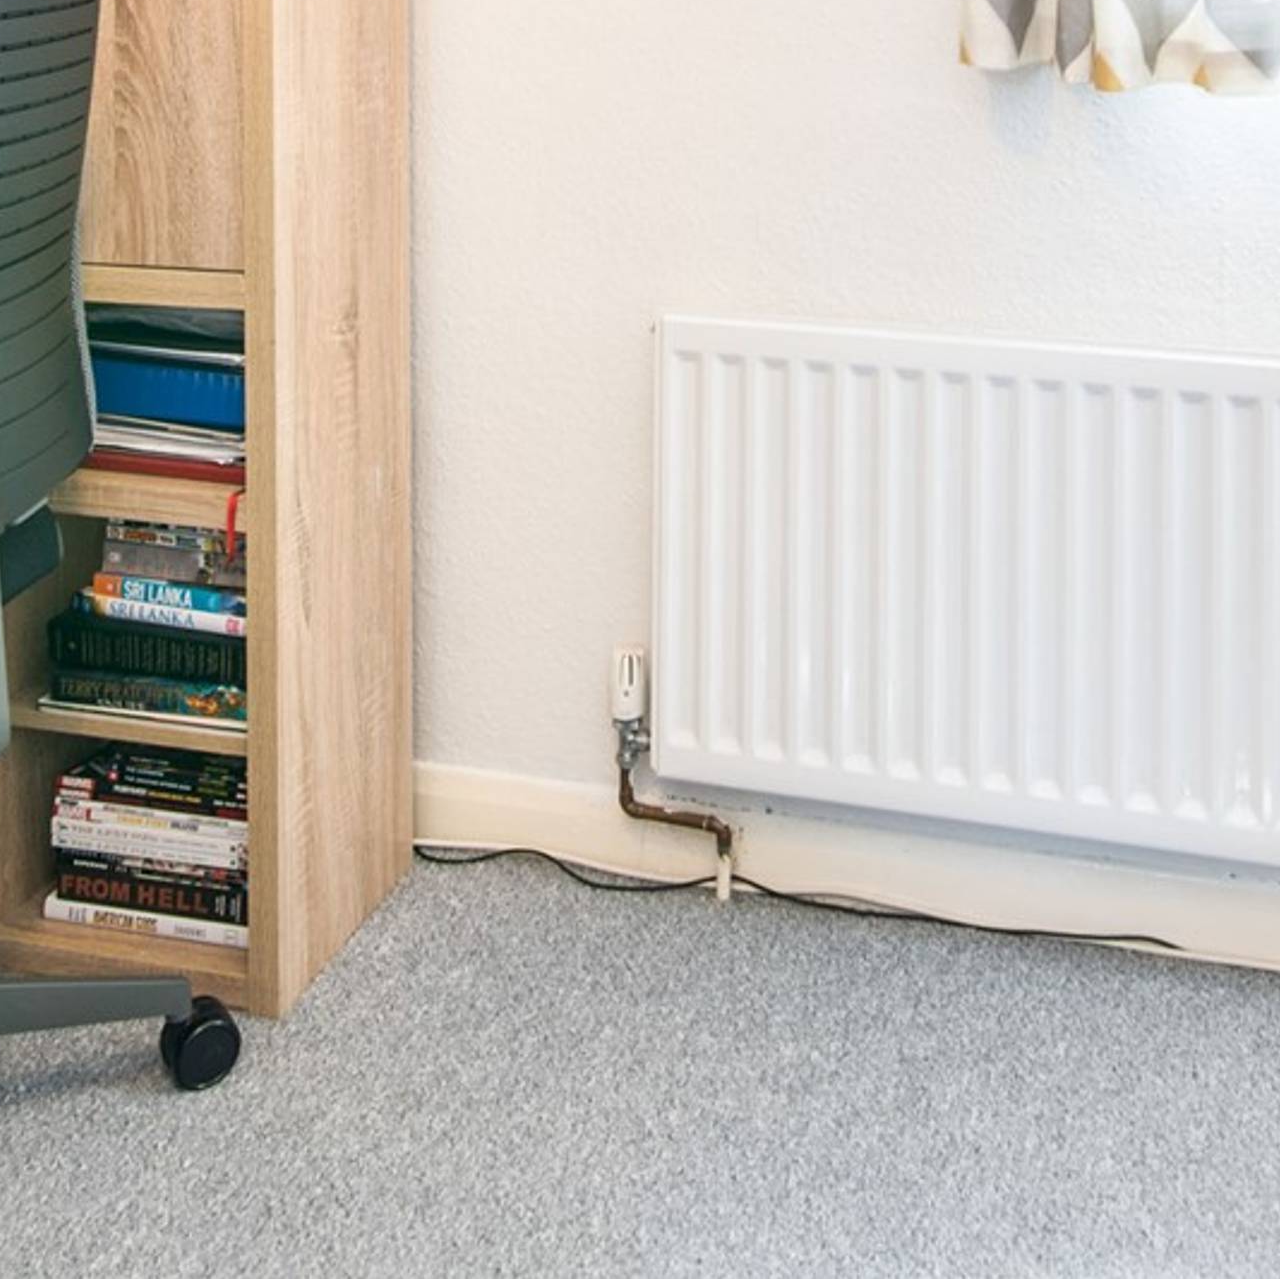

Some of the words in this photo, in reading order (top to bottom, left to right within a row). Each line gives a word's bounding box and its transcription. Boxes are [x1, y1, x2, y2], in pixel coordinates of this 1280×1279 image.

[124, 580, 145, 602] SRI
[148, 582, 193, 609] LANKA
[109, 601, 135, 618] SRI
[139, 605, 195, 629] LANKA
[61, 874, 131, 904] FROM
[137, 884, 208, 914] HELL
